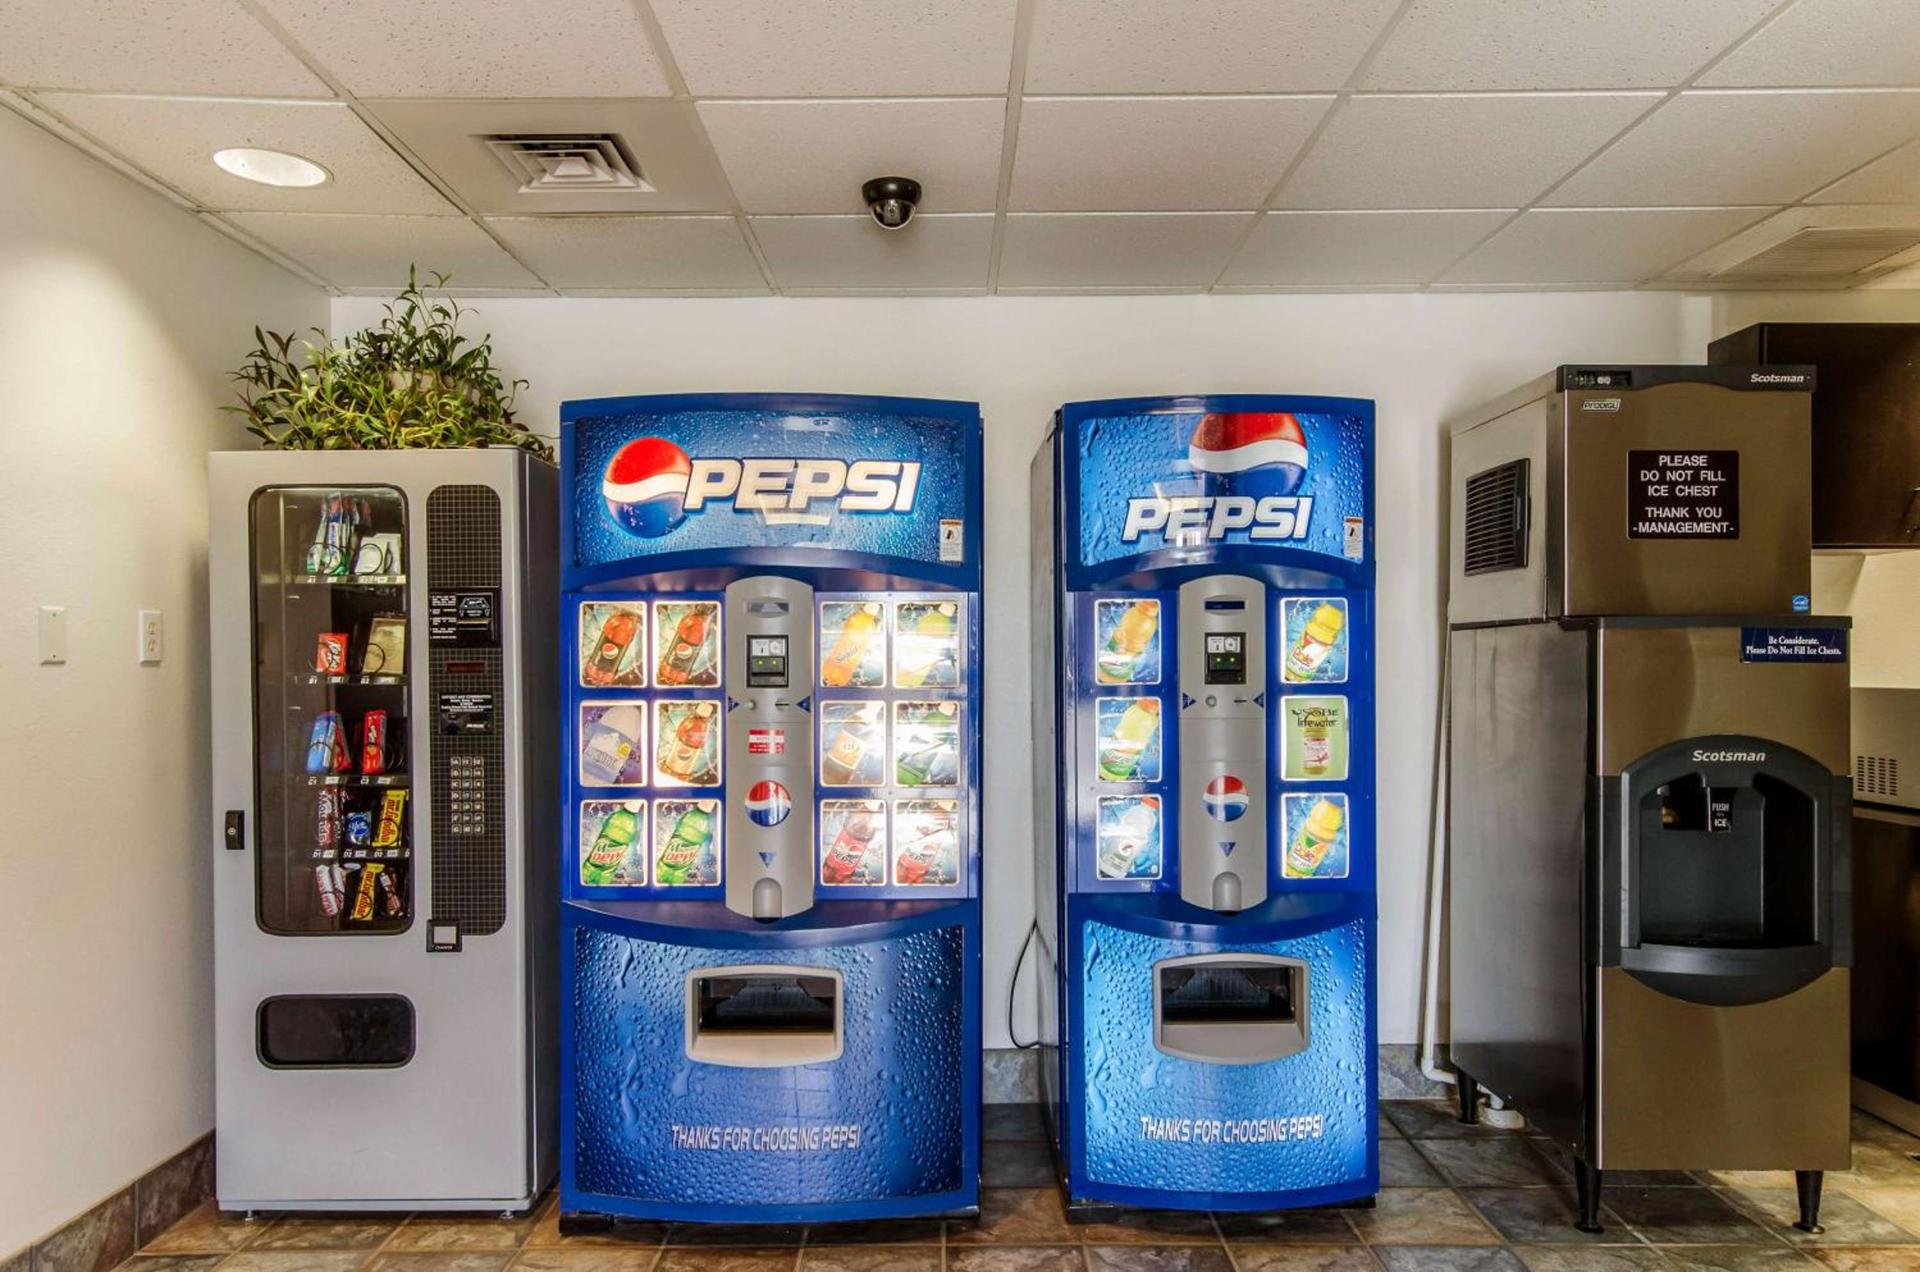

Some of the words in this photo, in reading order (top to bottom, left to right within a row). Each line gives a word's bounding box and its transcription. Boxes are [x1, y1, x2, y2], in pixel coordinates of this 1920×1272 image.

[1751, 373, 1804, 383] Scotsman
[1659, 455, 1708, 466] PLEASE
[1640, 470, 1659, 481] DO
[1666, 470, 1694, 481] NOT
[1700, 470, 1726, 481] FILL
[683, 457, 921, 513] PEPSI
[1648, 485, 1669, 496] ICE
[1675, 485, 1718, 496] CHEST
[1645, 507, 1690, 518] THANK
[1695, 507, 1722, 518] YOU
[1121, 496, 1313, 542] PEPSI
[1768, 636, 1777, 645] Be
[1778, 635, 1820, 645] Considerate.
[1746, 646, 1767, 655] Please
[1767, 646, 1779, 655] Do
[1779, 646, 1793, 655] Not
[1794, 646, 1806, 655] Fill
[1807, 646, 1817, 655] Ice
[1818, 646, 1842, 655] Chests.
[1692, 750, 1766, 761] Scotsman
[1712, 803, 1730, 811] PUSH
[1714, 819, 1727, 827] ICE
[1140, 1116, 1191, 1142] THANKS
[1193, 1118, 1221, 1143] FOR
[1223, 1117, 1287, 1143] CHOOSING
[1289, 1114, 1323, 1139] PEPSI
[671, 1125, 720, 1150] THANKS
[722, 1126, 751, 1151] FOR
[752, 1126, 819, 1150] CHOOSING
[821, 1124, 861, 1149] PEPSI
